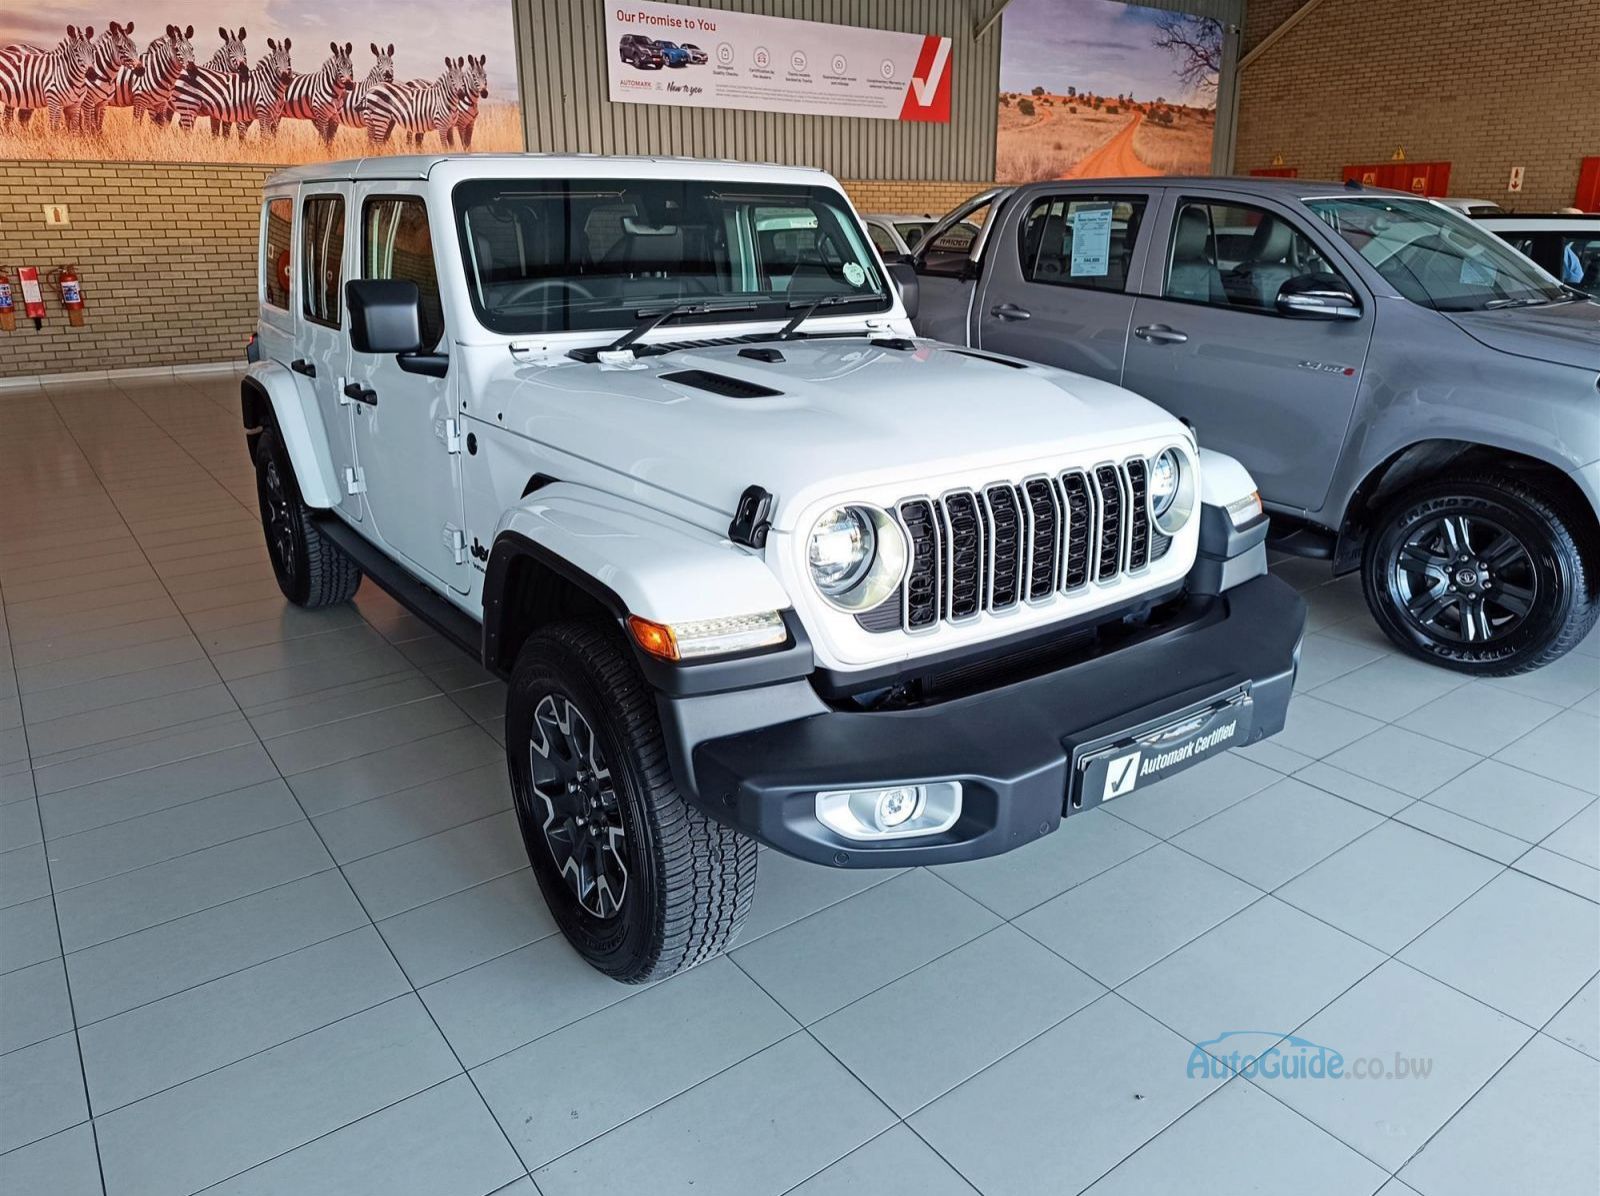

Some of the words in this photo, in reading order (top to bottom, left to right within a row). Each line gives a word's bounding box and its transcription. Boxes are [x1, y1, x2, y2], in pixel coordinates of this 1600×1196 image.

[616, 9, 636, 23] Our
[638, 12, 682, 28] Promise
[684, 18, 696, 29] to
[697, 18, 717, 31] You
[619, 79, 652, 88] AUTOMARK
[666, 81, 681, 93] New
[681, 84, 689, 92] to
[689, 86, 703, 96] you
[1140, 741, 1193, 776] Automark
[1194, 720, 1237, 754] Certified
